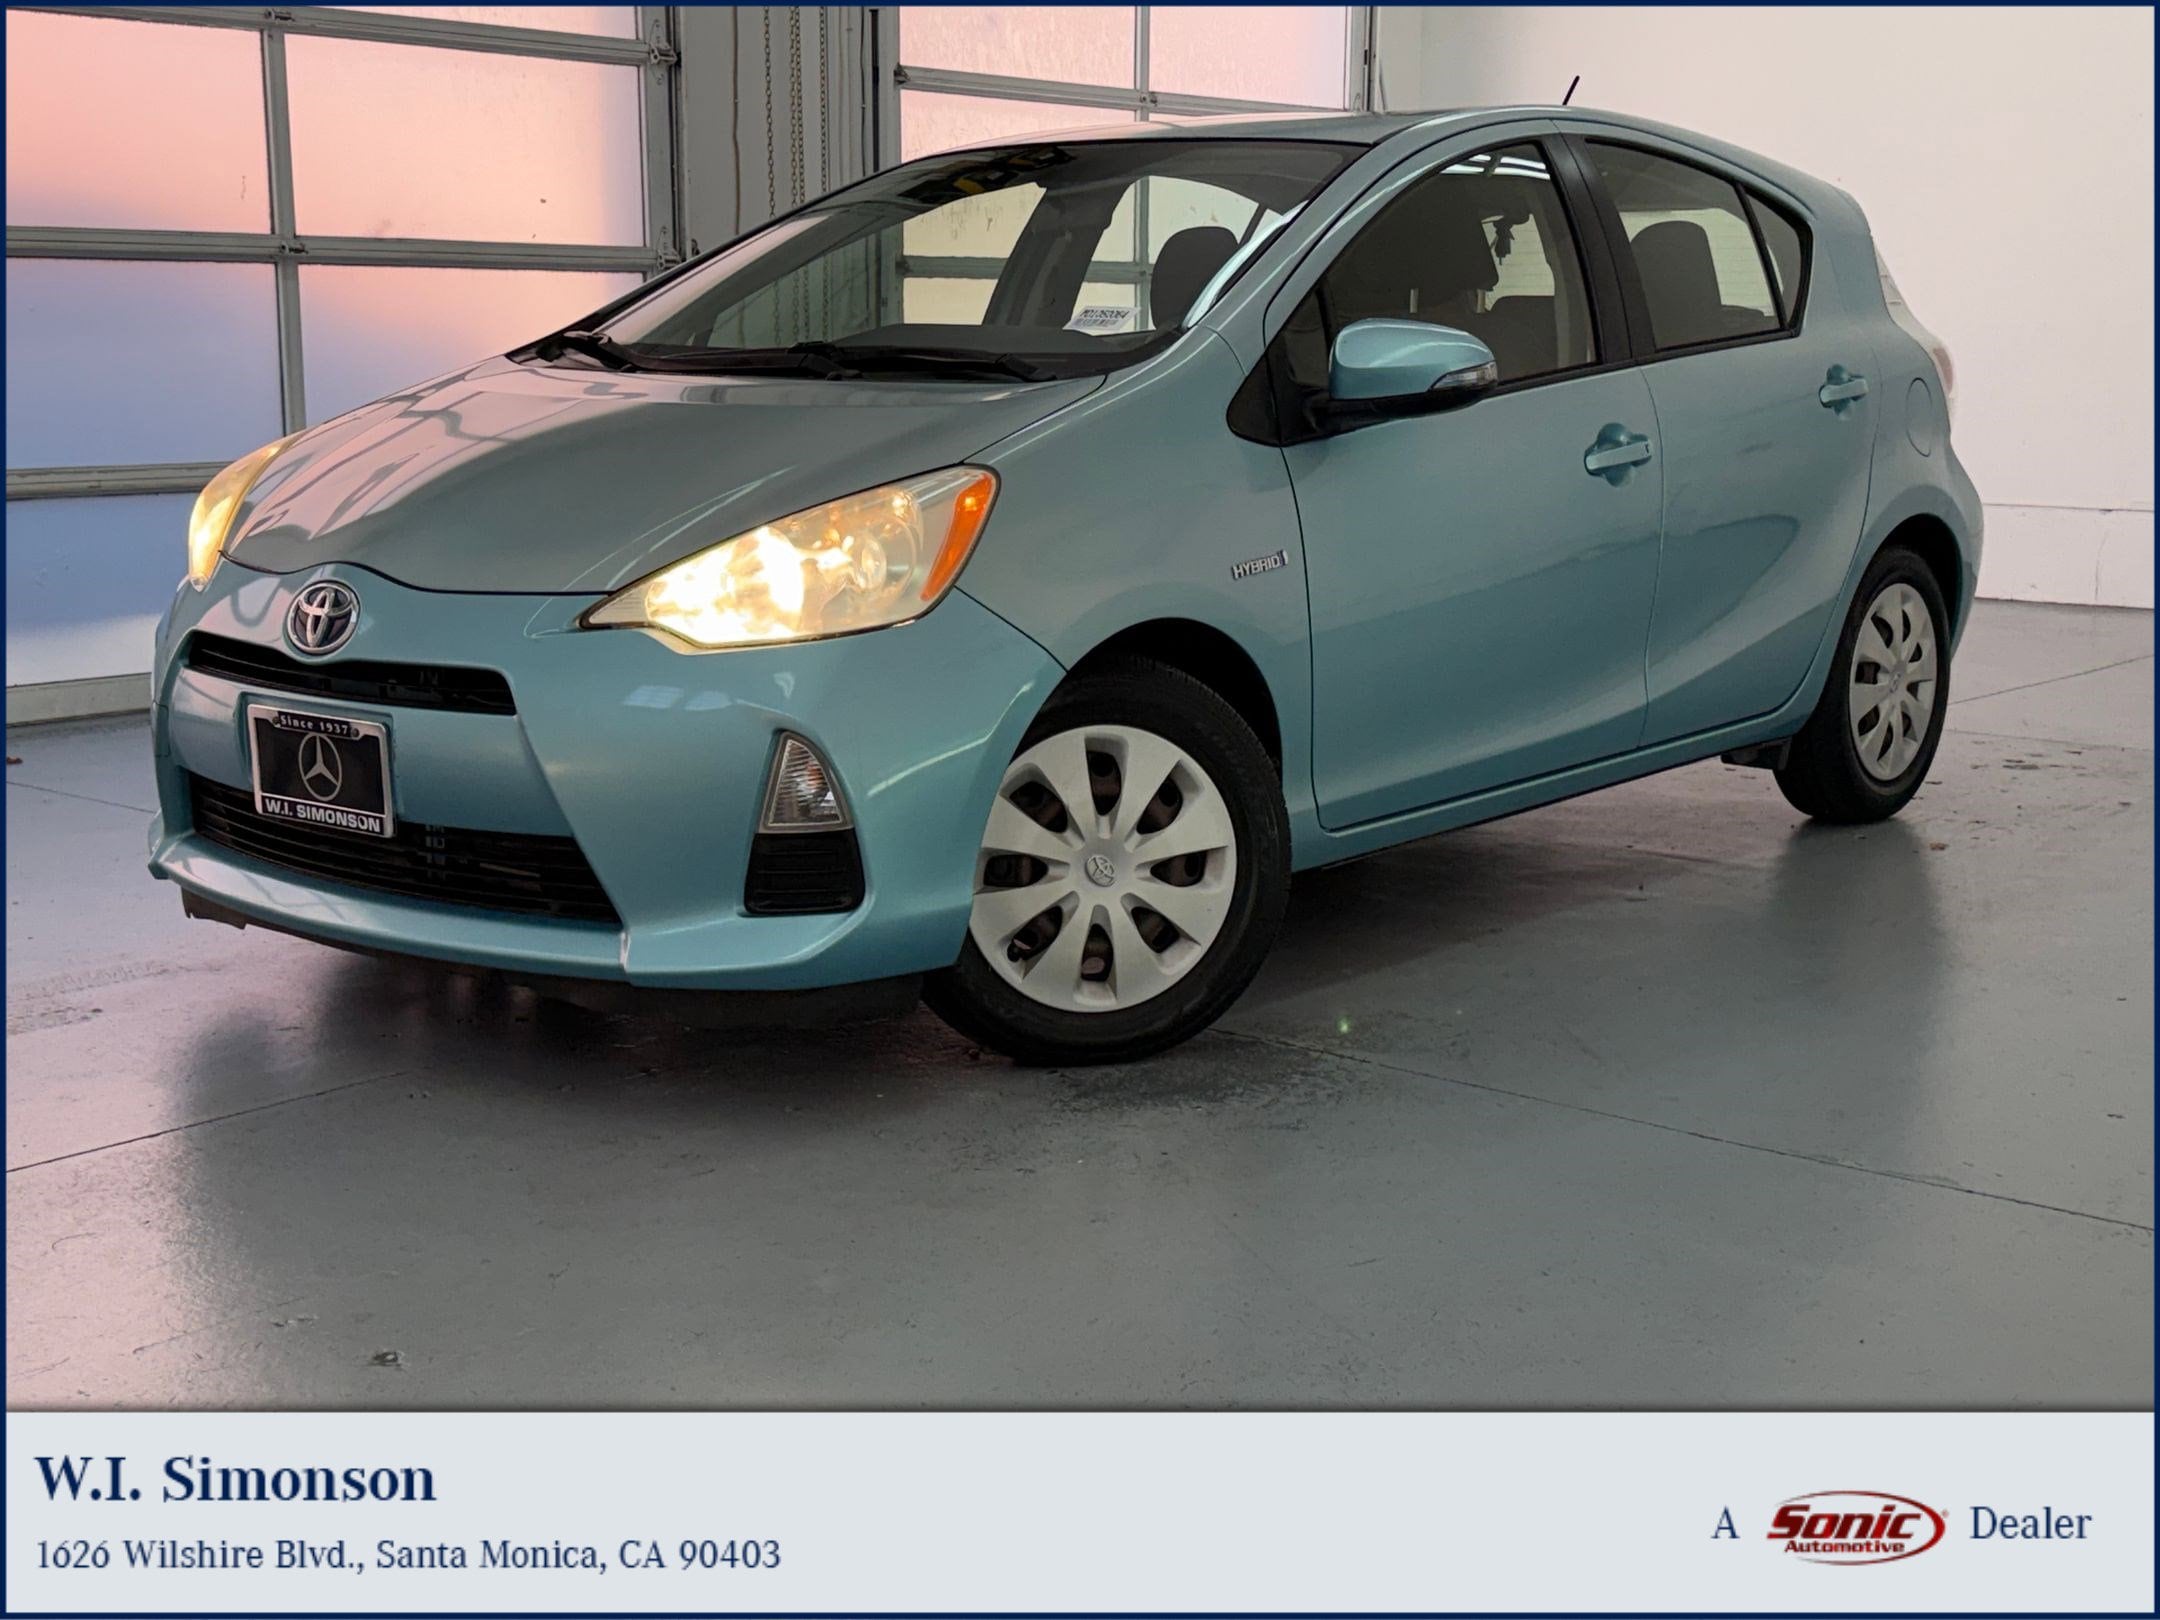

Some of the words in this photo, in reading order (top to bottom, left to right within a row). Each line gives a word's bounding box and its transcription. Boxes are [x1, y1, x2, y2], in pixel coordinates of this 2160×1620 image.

[1231, 555, 1281, 580] HYBRID
[280, 714, 313, 730] Since
[319, 721, 349, 735] 1937
[264, 798, 293, 816] W.I.
[296, 804, 381, 833] SIMONSON
